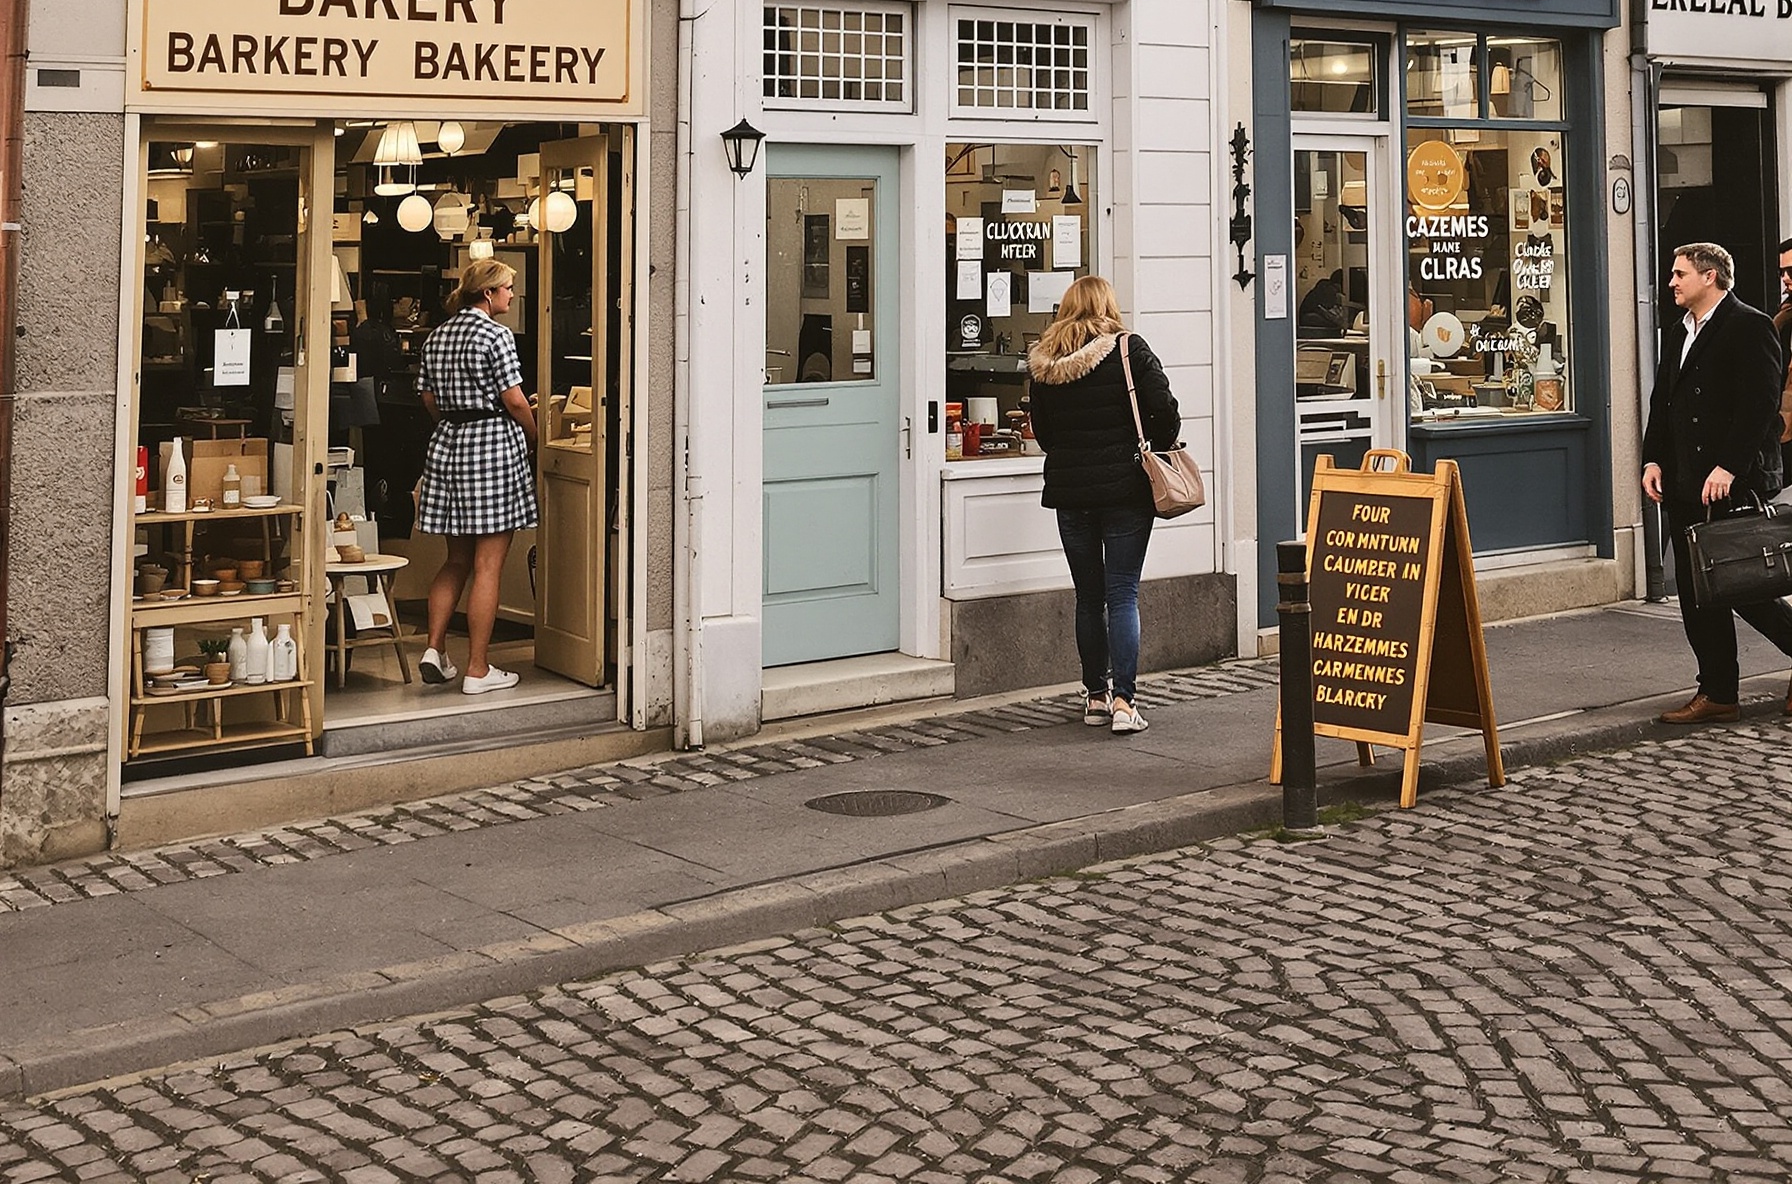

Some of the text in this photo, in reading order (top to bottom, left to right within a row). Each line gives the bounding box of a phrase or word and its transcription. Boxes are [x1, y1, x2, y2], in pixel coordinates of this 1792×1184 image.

[167, 31, 606, 85] BARKERY BAKEERY
[1406, 215, 1489, 238] CAZEMES
[1420, 257, 1483, 280] CLRAS
[1352, 504, 1391, 524] FOUR
[1313, 631, 1409, 659] HARZEMMES
